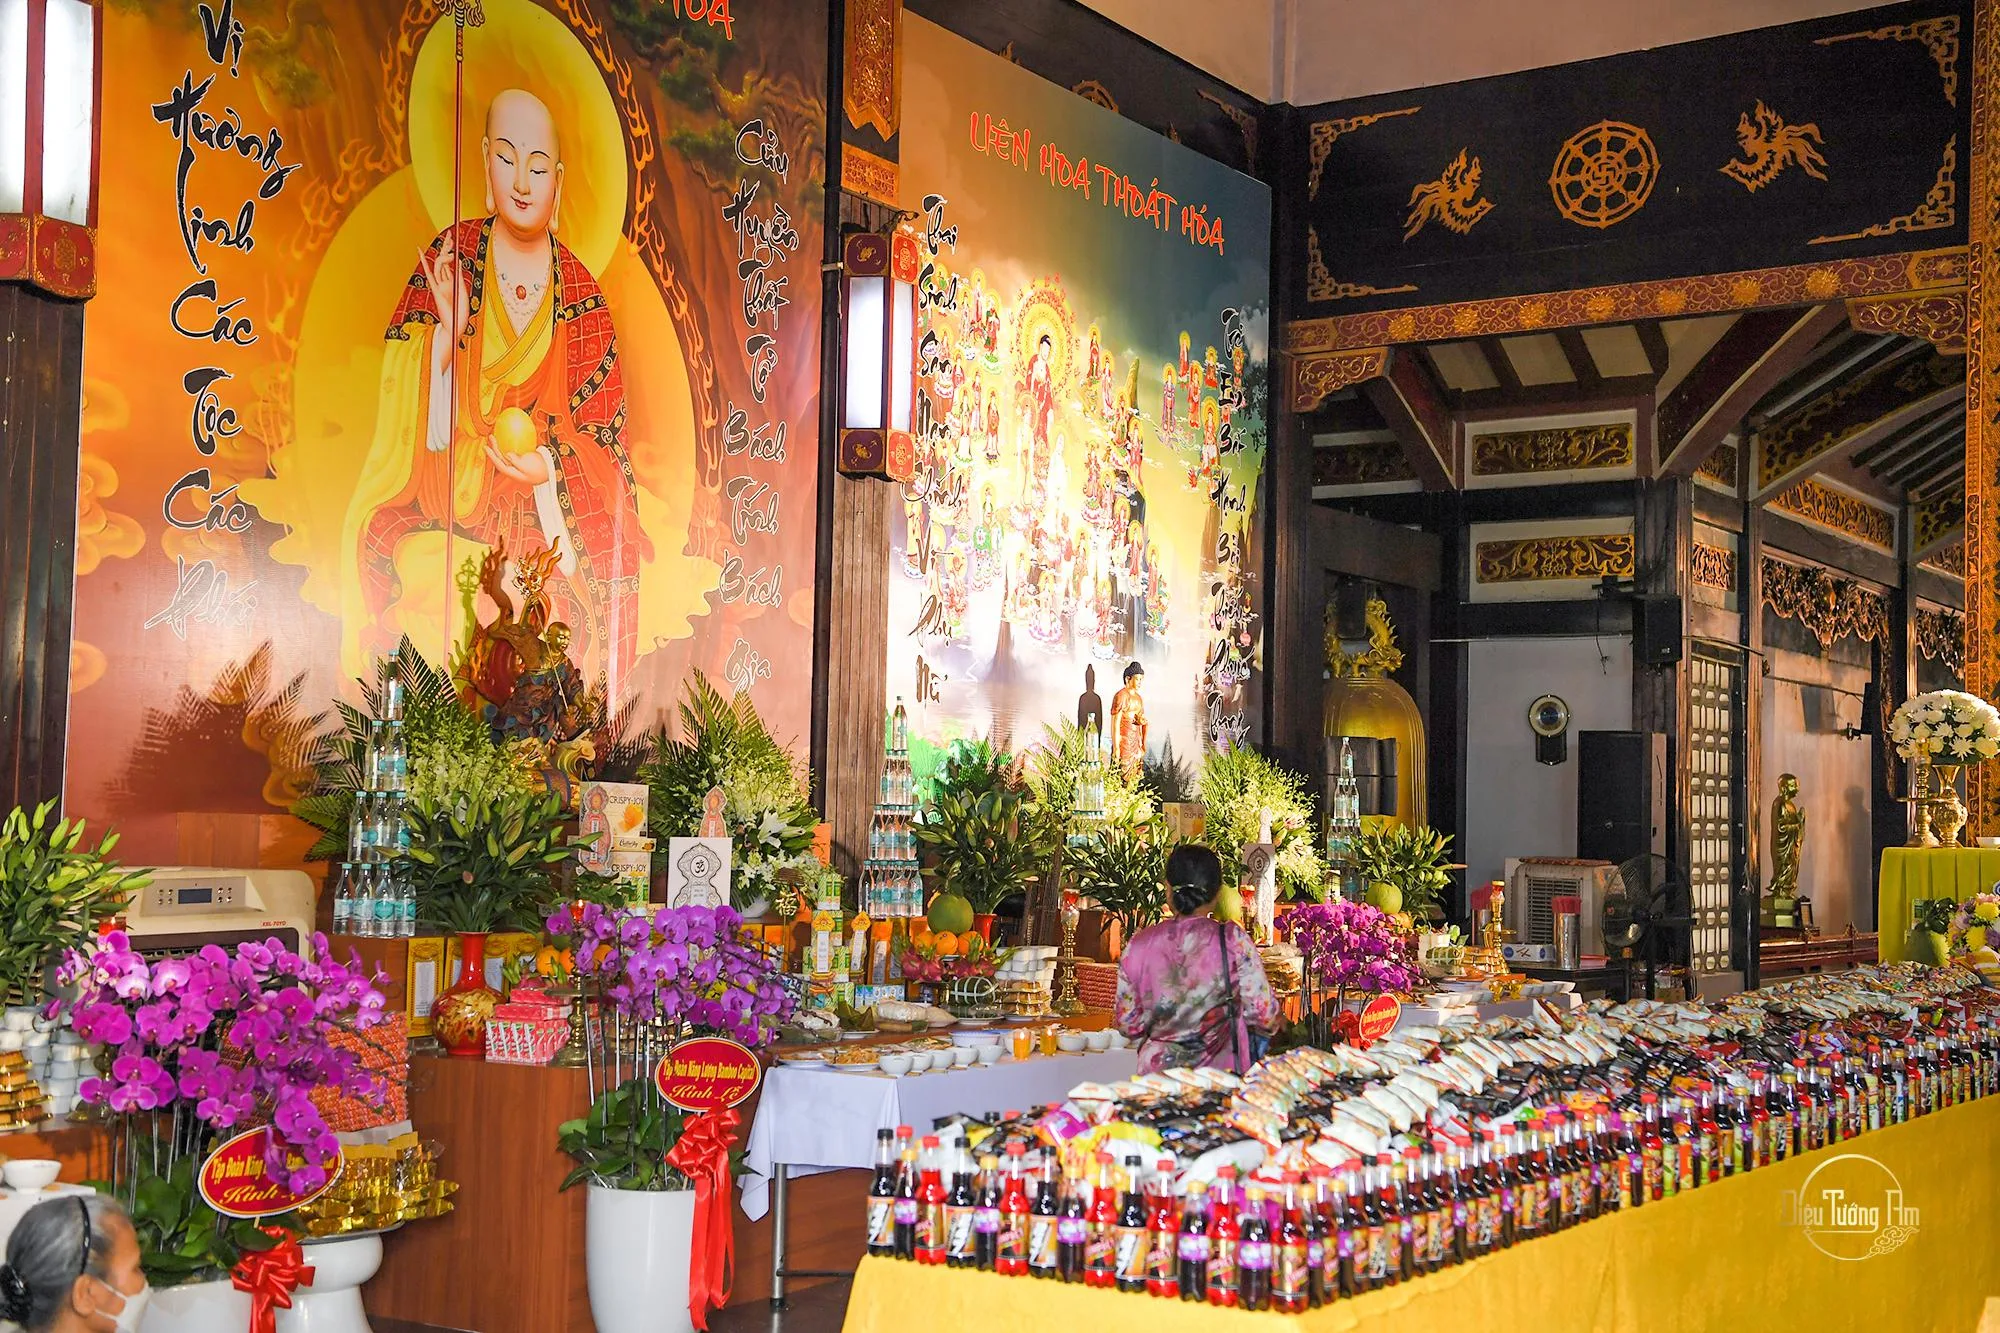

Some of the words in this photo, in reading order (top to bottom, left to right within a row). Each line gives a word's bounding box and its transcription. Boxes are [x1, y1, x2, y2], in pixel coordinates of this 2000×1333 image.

[969, 112, 1031, 171] LIÊN
[1039, 143, 1092, 200] HOA
[1095, 164, 1177, 231] THOÁT
[1181, 205, 1225, 256] HÓA
[169, 278, 259, 346] Các
[724, 401, 786, 464] Bách
[162, 467, 253, 533] Các
[719, 550, 783, 608] Bách
